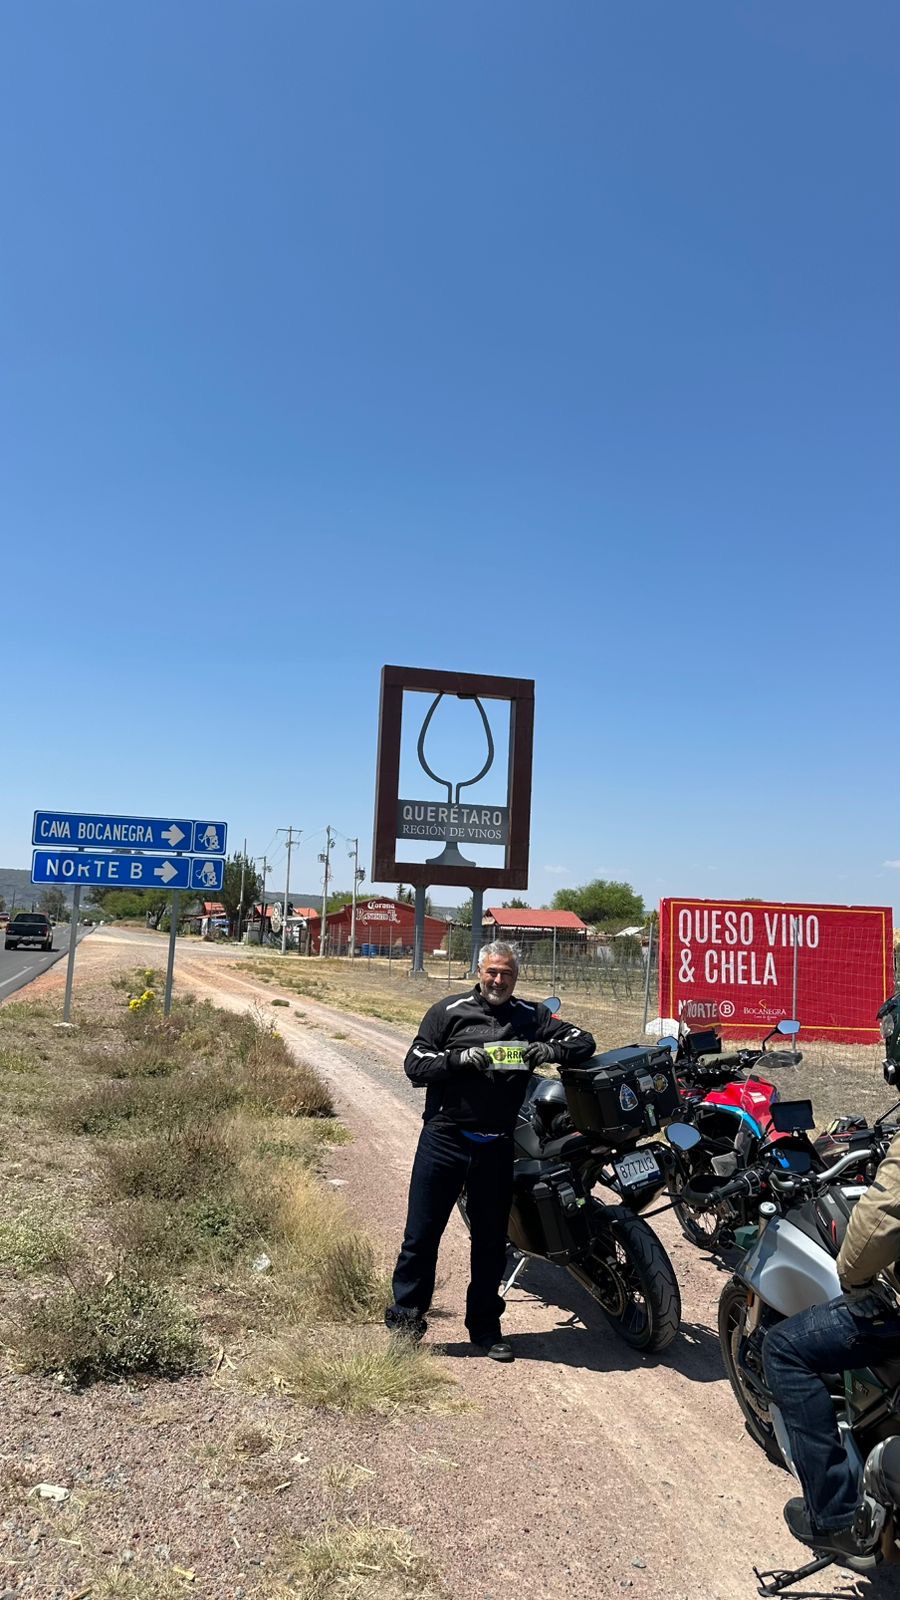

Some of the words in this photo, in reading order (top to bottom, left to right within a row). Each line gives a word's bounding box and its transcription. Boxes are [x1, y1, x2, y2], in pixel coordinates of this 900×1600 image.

[403, 805, 502, 826] QUERÉTARO
[41, 819, 71, 839] CAVA
[78, 822, 154, 843] BOCANEGRA
[402, 823, 446, 836] REGIÓN
[449, 827, 465, 837] DE
[468, 828, 502, 839] VINOS
[46, 858, 120, 879] NORTE
[130, 862, 143, 880] B
[678, 908, 754, 947] QUESO
[763, 912, 820, 949] VINO
[678, 948, 695, 983] &
[704, 949, 778, 986] CHELA
[743, 1006, 787, 1015] BOCANEGRA
[620, 1156, 655, 1179] 87TZU3
